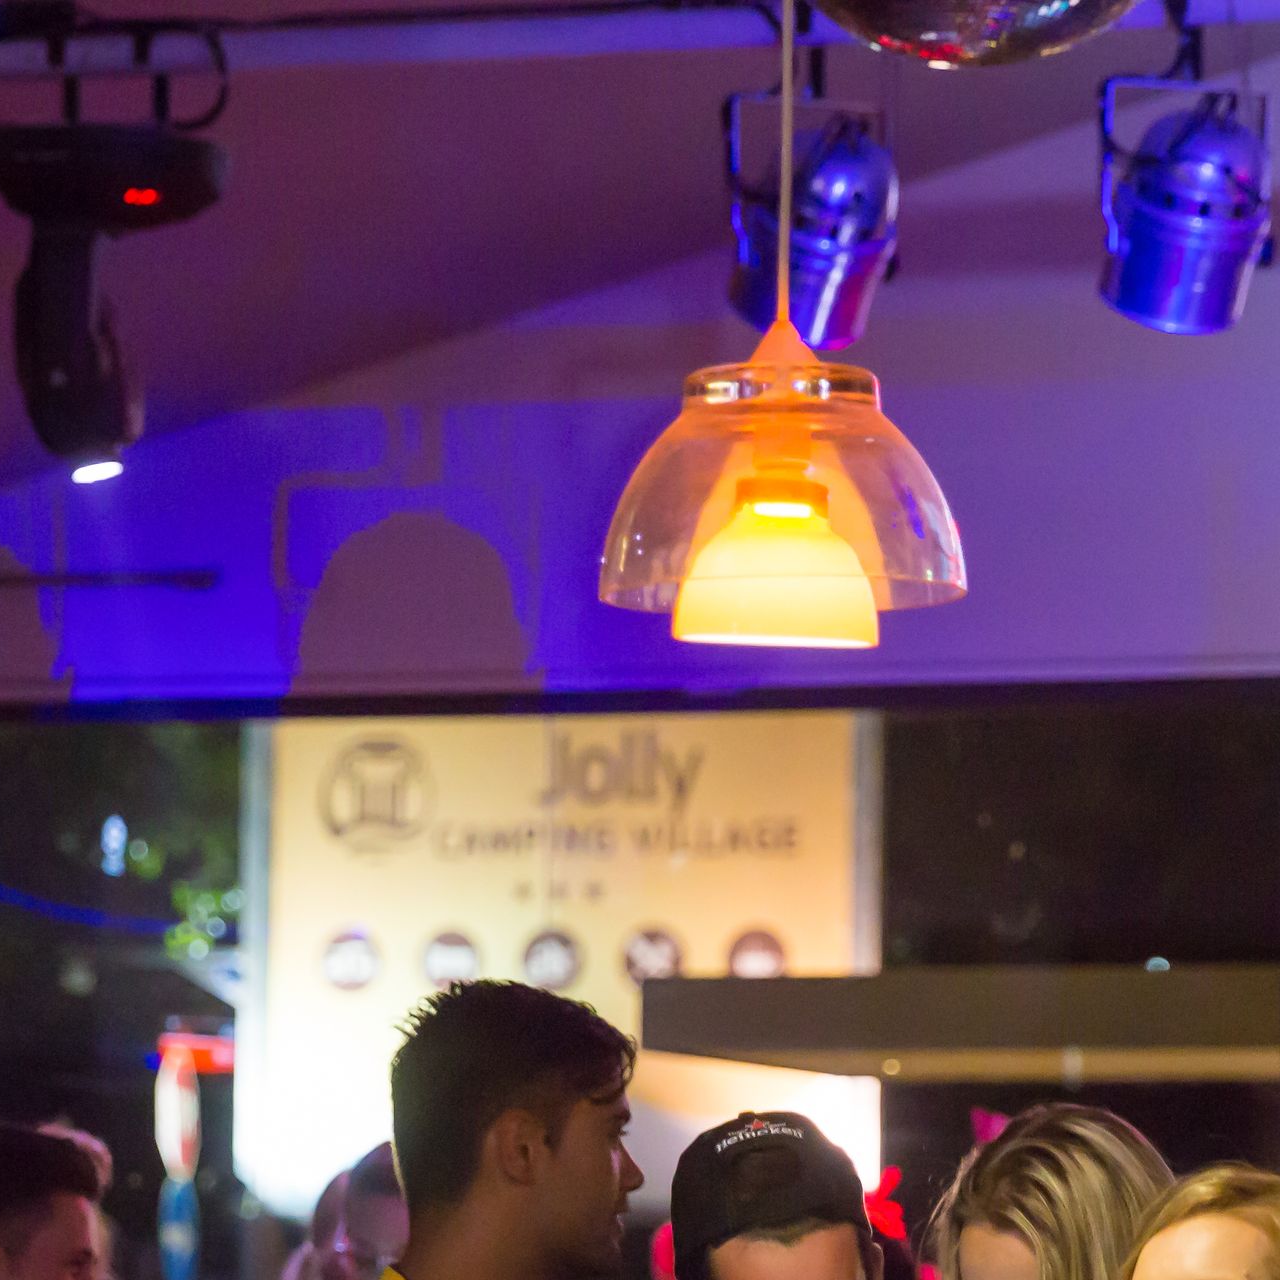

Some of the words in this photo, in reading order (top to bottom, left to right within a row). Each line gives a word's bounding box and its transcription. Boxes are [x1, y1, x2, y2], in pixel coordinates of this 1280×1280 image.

[534, 724, 705, 818] Jolly
[433, 819, 616, 858] CAMPING
[634, 817, 800, 857] VILLAGE
